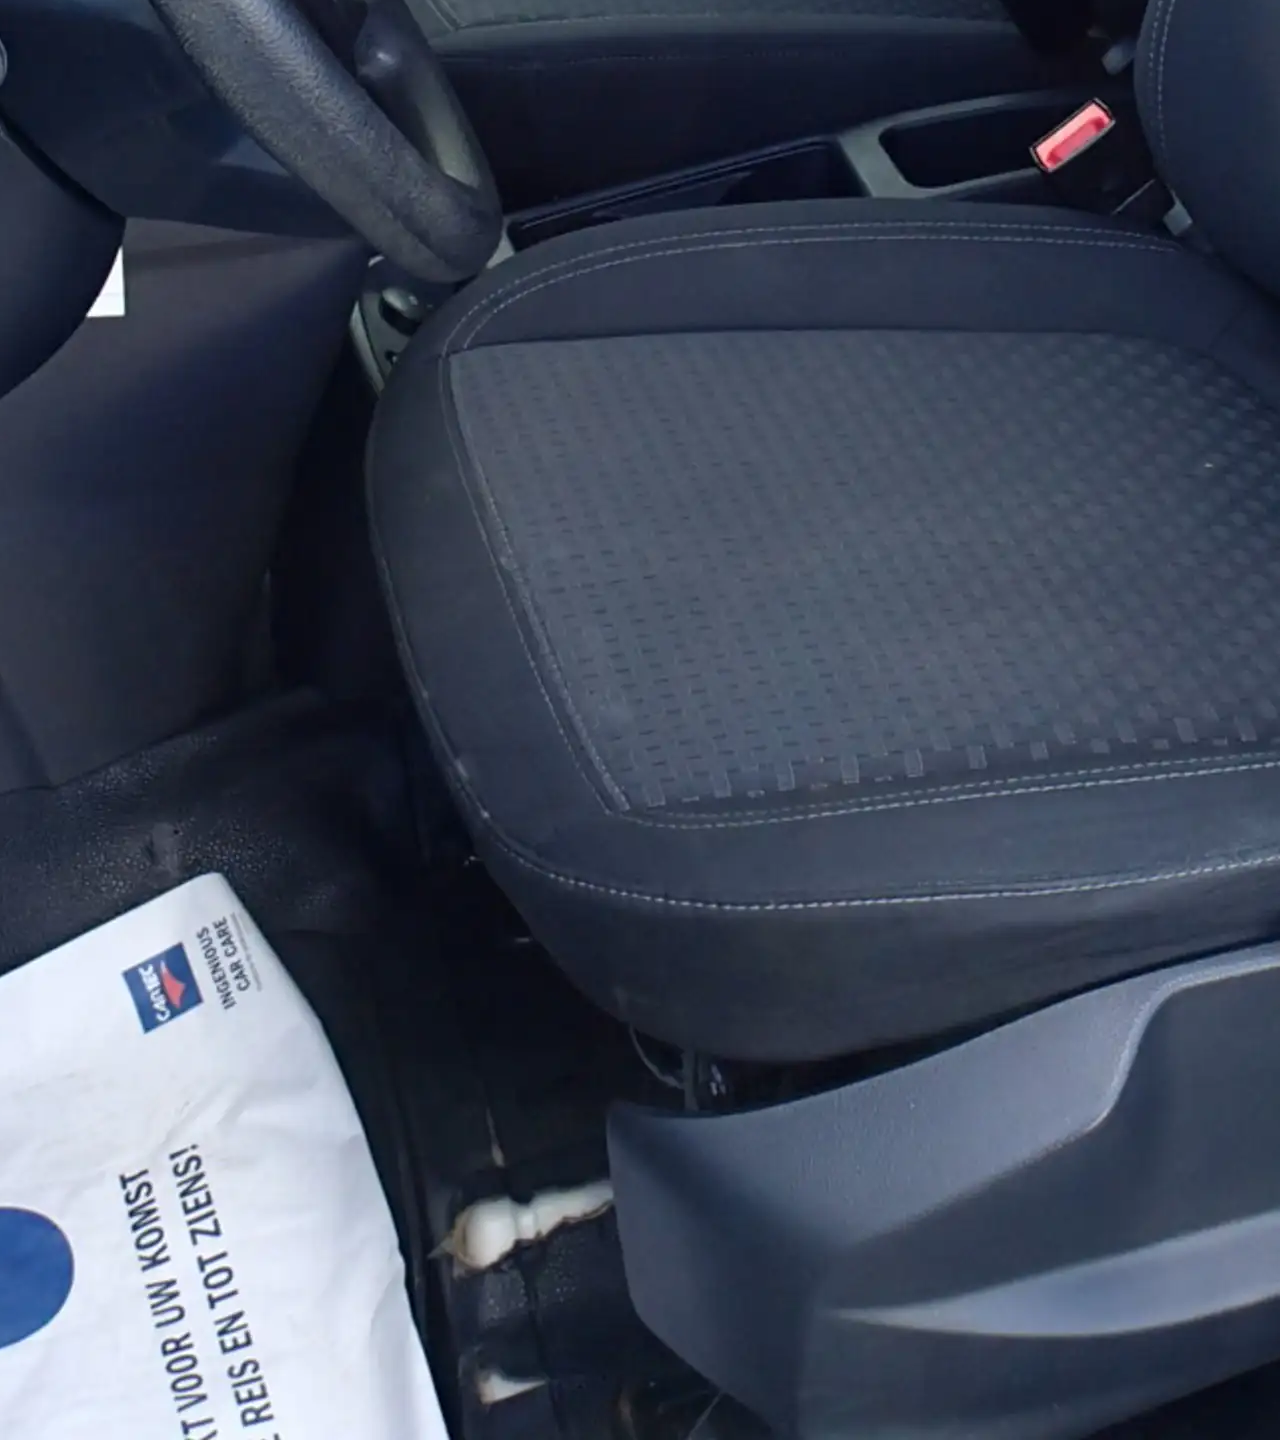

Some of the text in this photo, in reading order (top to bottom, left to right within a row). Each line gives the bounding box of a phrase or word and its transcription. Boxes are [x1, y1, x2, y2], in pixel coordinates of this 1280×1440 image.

[196, 926, 237, 1010] INGENIOUS
[212, 916, 237, 958] CARE
[230, 958, 251, 992] CAR
[118, 1168, 171, 1273] KOMST
[168, 1143, 222, 1246] ZIENS!
[145, 1278, 186, 1329] UW
[197, 1250, 238, 1310] TOT
[214, 1310, 253, 1355] EN
[160, 1331, 208, 1413] VOOR
[227, 1358, 274, 1428] REIS
